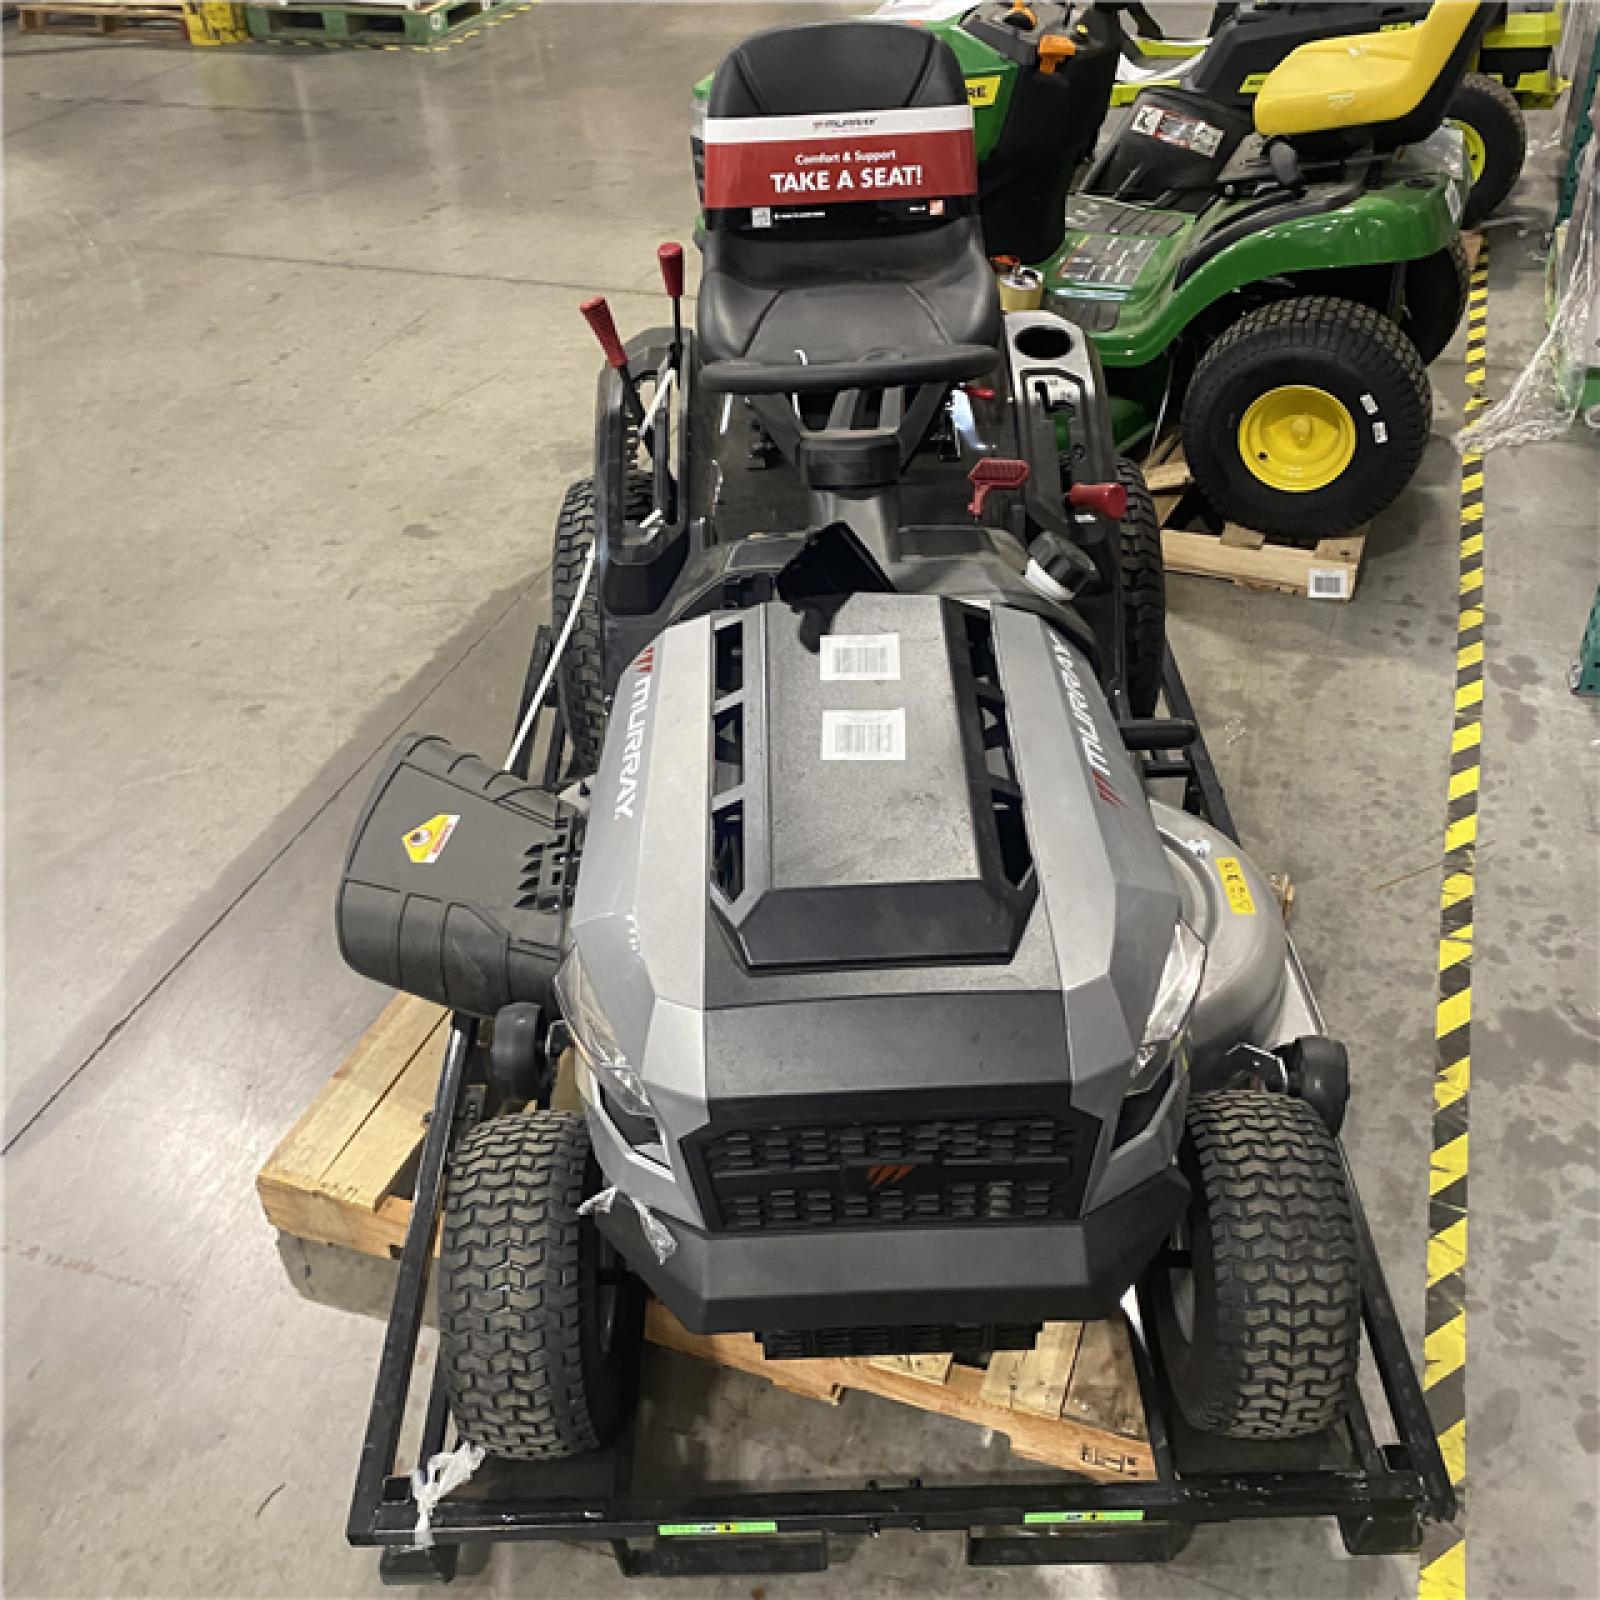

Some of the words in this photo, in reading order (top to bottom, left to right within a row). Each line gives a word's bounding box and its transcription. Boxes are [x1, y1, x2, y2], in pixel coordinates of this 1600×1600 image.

[770, 171, 830, 193] TAKE
[837, 169, 855, 190] A
[860, 165, 923, 188] SEAT!
[795, 153, 841, 166] Comfort
[842, 152, 851, 163] &
[854, 150, 896, 163] Support
[1049, 632, 1111, 776] MURRAY
[614, 675, 651, 821] MURRAY
